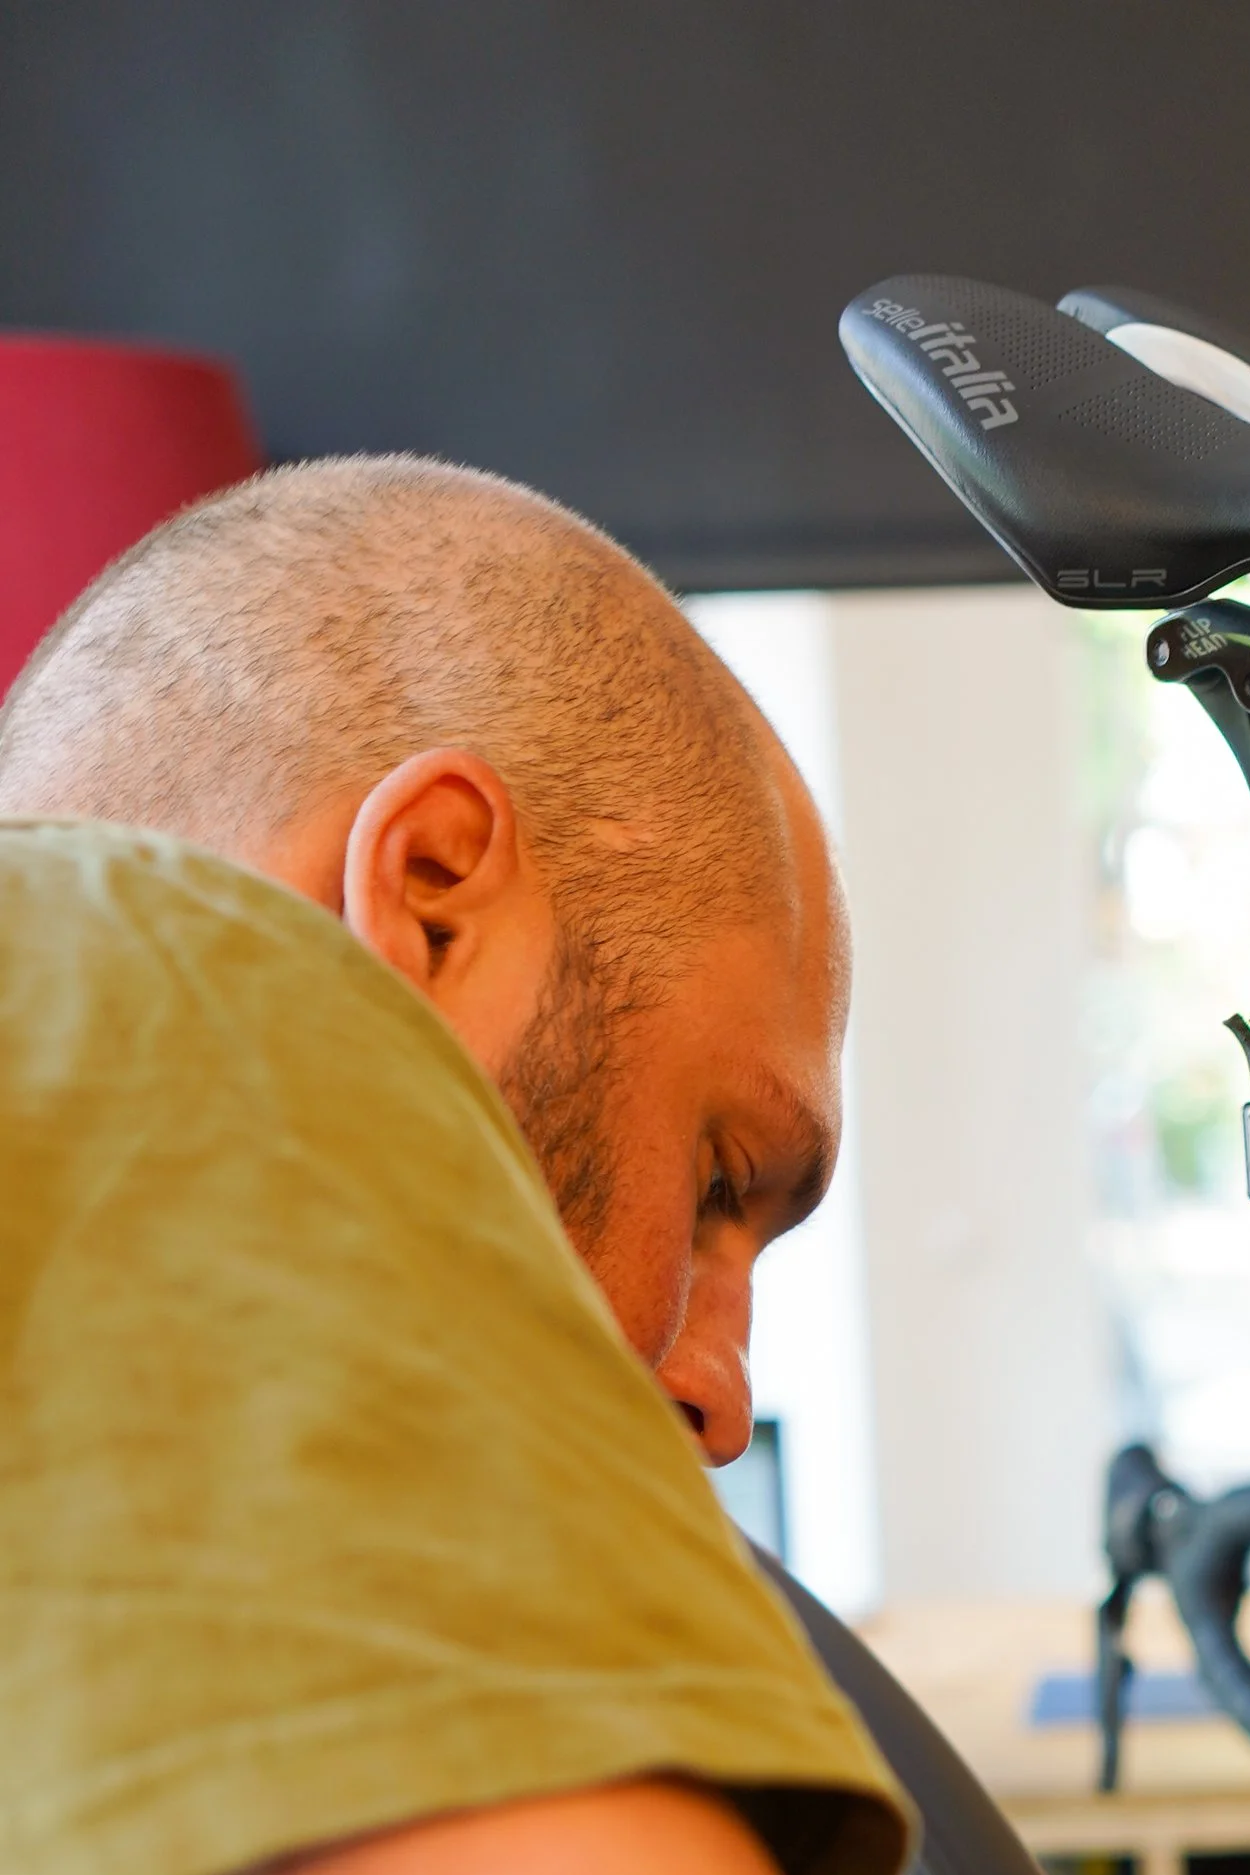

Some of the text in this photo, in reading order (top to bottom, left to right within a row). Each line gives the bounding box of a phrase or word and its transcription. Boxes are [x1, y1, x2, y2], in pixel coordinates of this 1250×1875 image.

[862, 298, 1019, 431] selle italia
[1057, 568, 1168, 588] SLR
